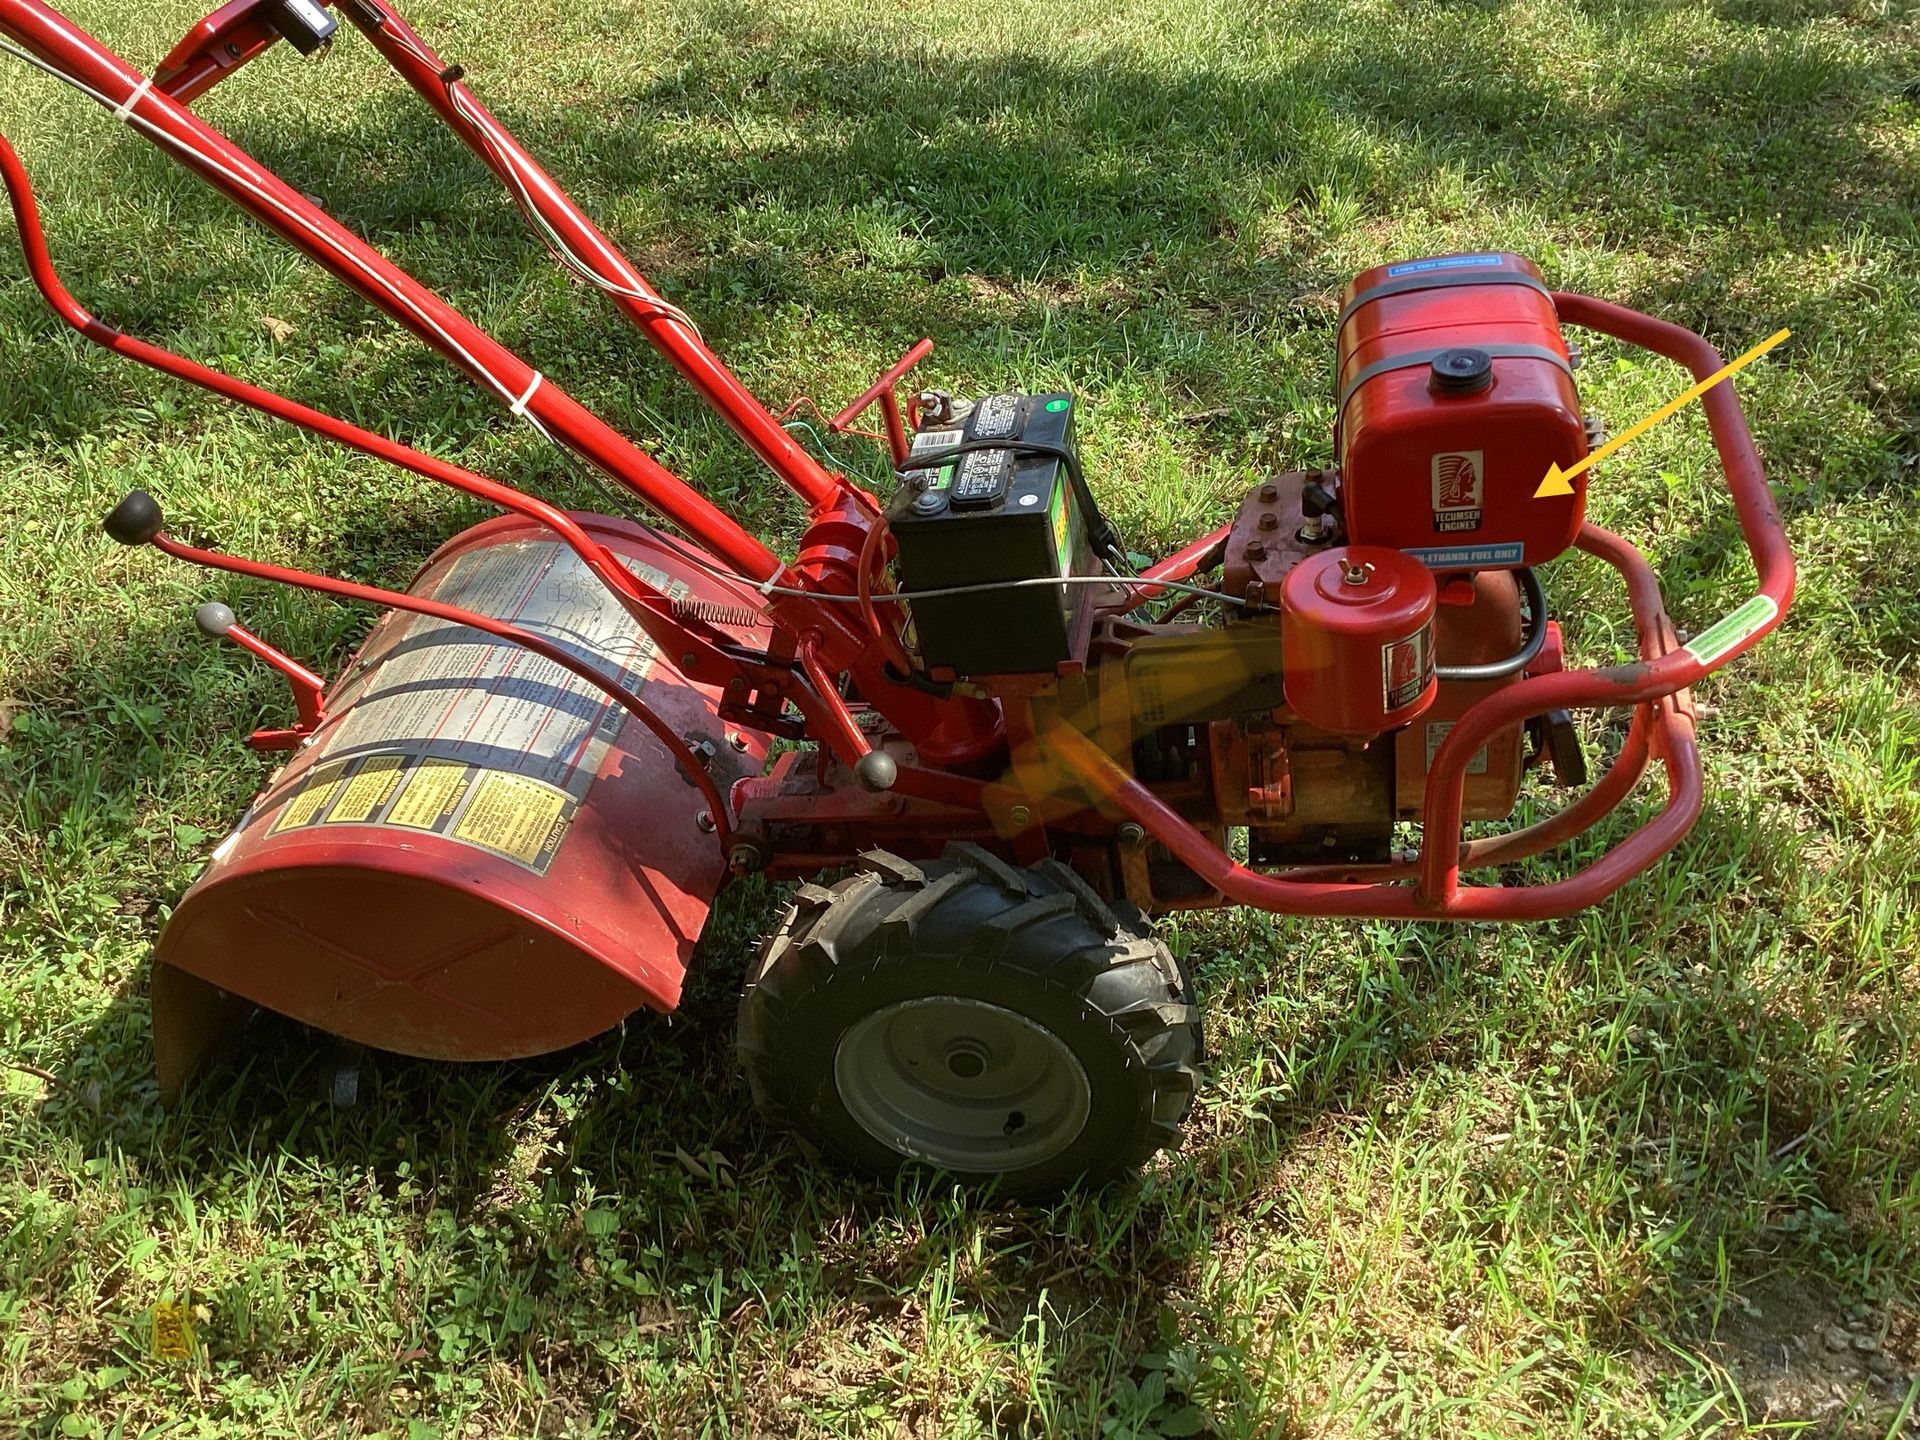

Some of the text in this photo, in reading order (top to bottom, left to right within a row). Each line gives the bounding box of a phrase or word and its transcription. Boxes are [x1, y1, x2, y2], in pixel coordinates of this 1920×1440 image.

[1436, 510, 1480, 522] TECUMSEH
[1440, 521, 1476, 531] ENGINES
[1472, 551, 1492, 560] FUEL
[1494, 549, 1517, 559] ONLY
[443, 785, 468, 816] WARNING
[544, 824, 564, 852] CAUTION
